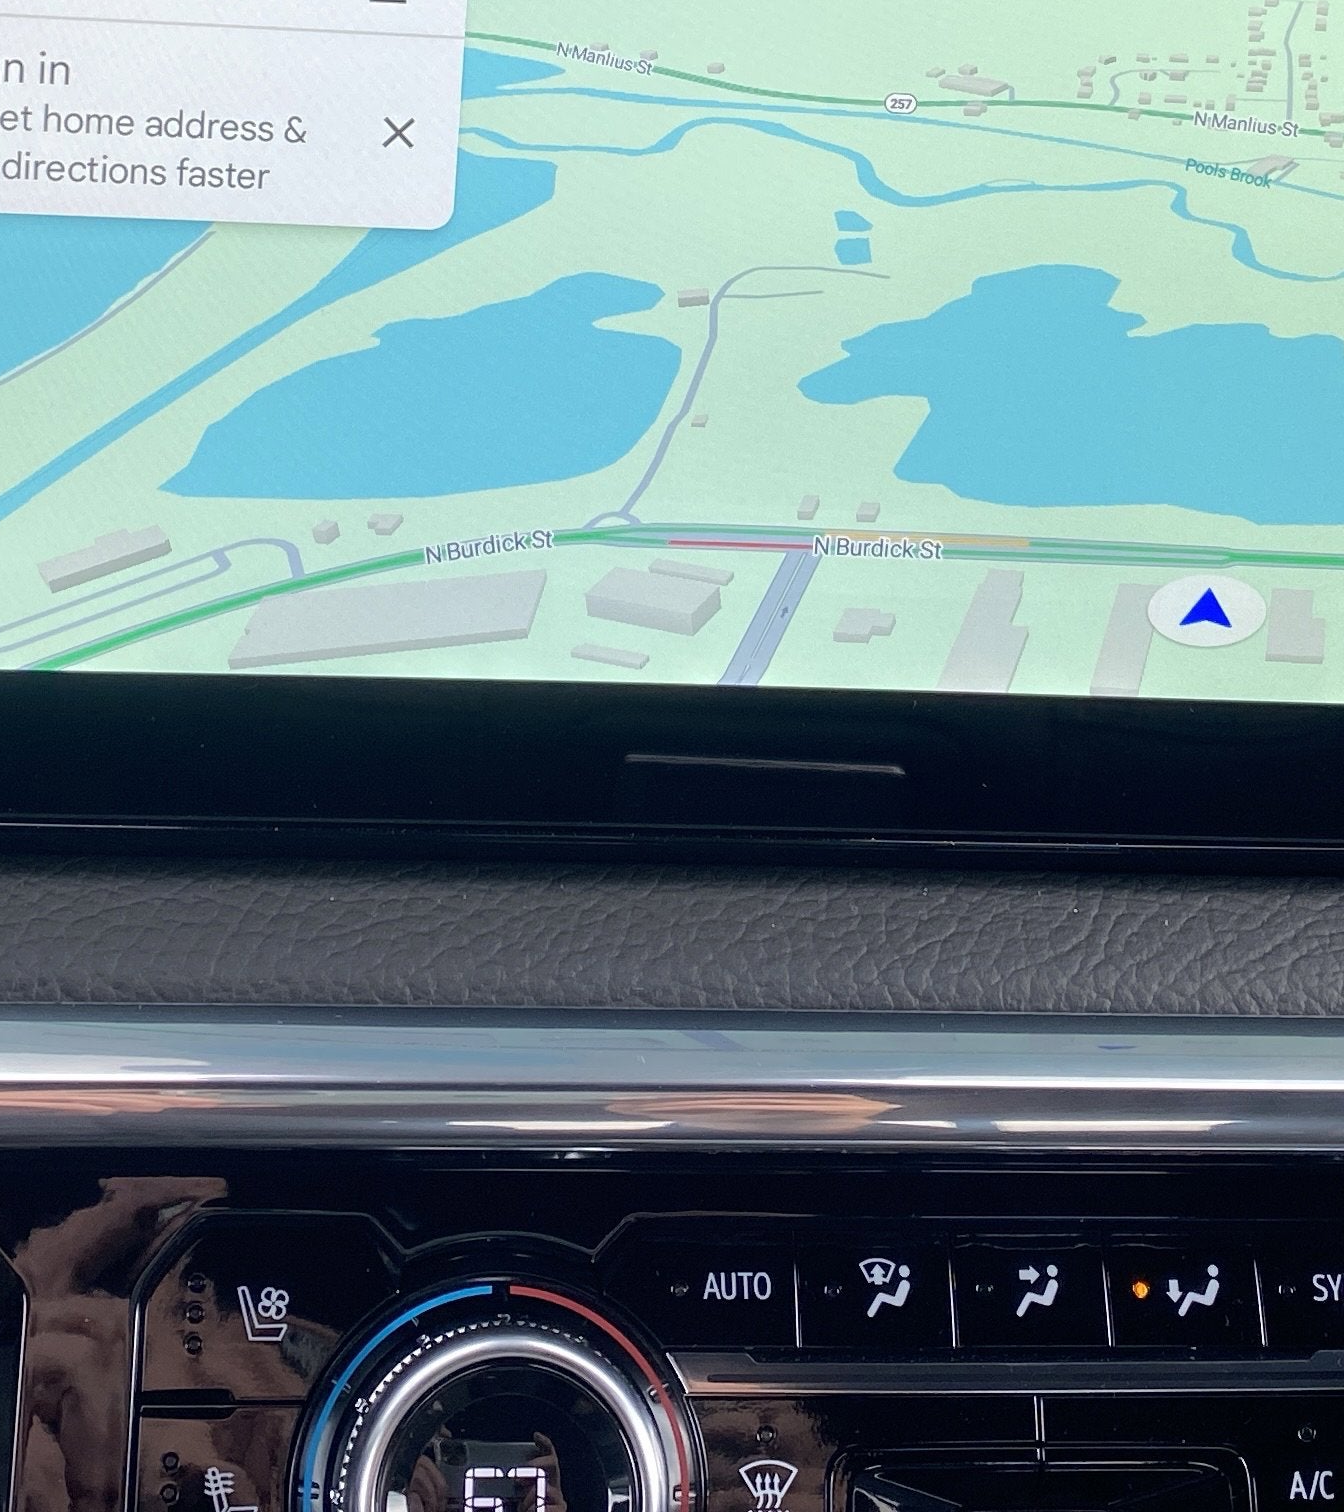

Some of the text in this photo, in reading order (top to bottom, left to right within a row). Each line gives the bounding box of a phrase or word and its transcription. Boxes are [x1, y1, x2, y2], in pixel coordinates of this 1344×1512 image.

[39, 51, 70, 85] in
[556, 42, 653, 76] N Manlius St
[890, 99, 912, 110] 257
[43, 104, 135, 137] home
[145, 110, 274, 142] address
[284, 116, 307, 144] &
[1194, 111, 1299, 138] N Manlius St
[2, 151, 167, 186] directions
[176, 157, 271, 190] faster
[1185, 158, 1273, 189] Pools Brook
[425, 530, 553, 564] N Burdick St
[814, 537, 941, 560] N Burdick St
[703, 1271, 772, 1301] AUTO
[1289, 1470, 1335, 1501] A/C
